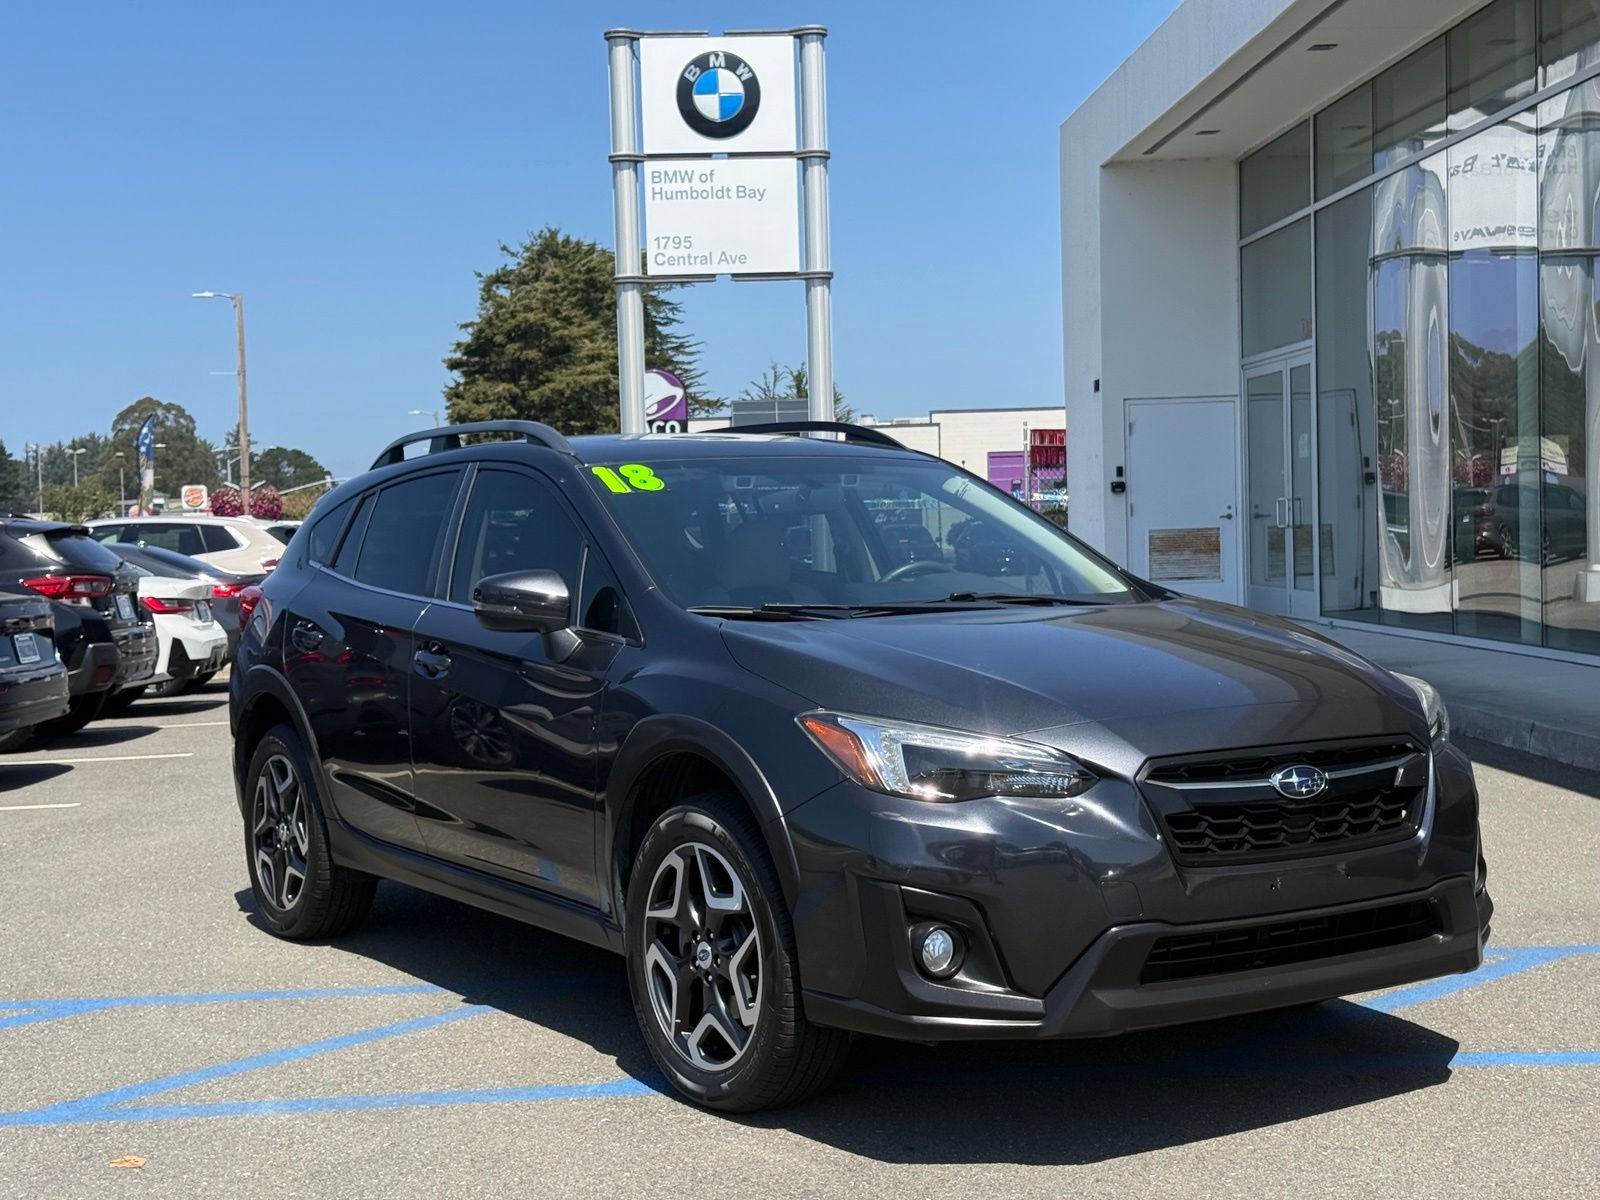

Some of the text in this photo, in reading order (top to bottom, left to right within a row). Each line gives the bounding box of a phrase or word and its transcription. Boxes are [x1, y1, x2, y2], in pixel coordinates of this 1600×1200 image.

[683, 51, 753, 83] BMW
[651, 169, 716, 184] BMW of
[651, 185, 767, 202] Humboldt Bay
[653, 235, 693, 250] 1795
[654, 251, 748, 267] Central Ave
[645, 420, 682, 434] CO
[591, 464, 665, 494] 18
